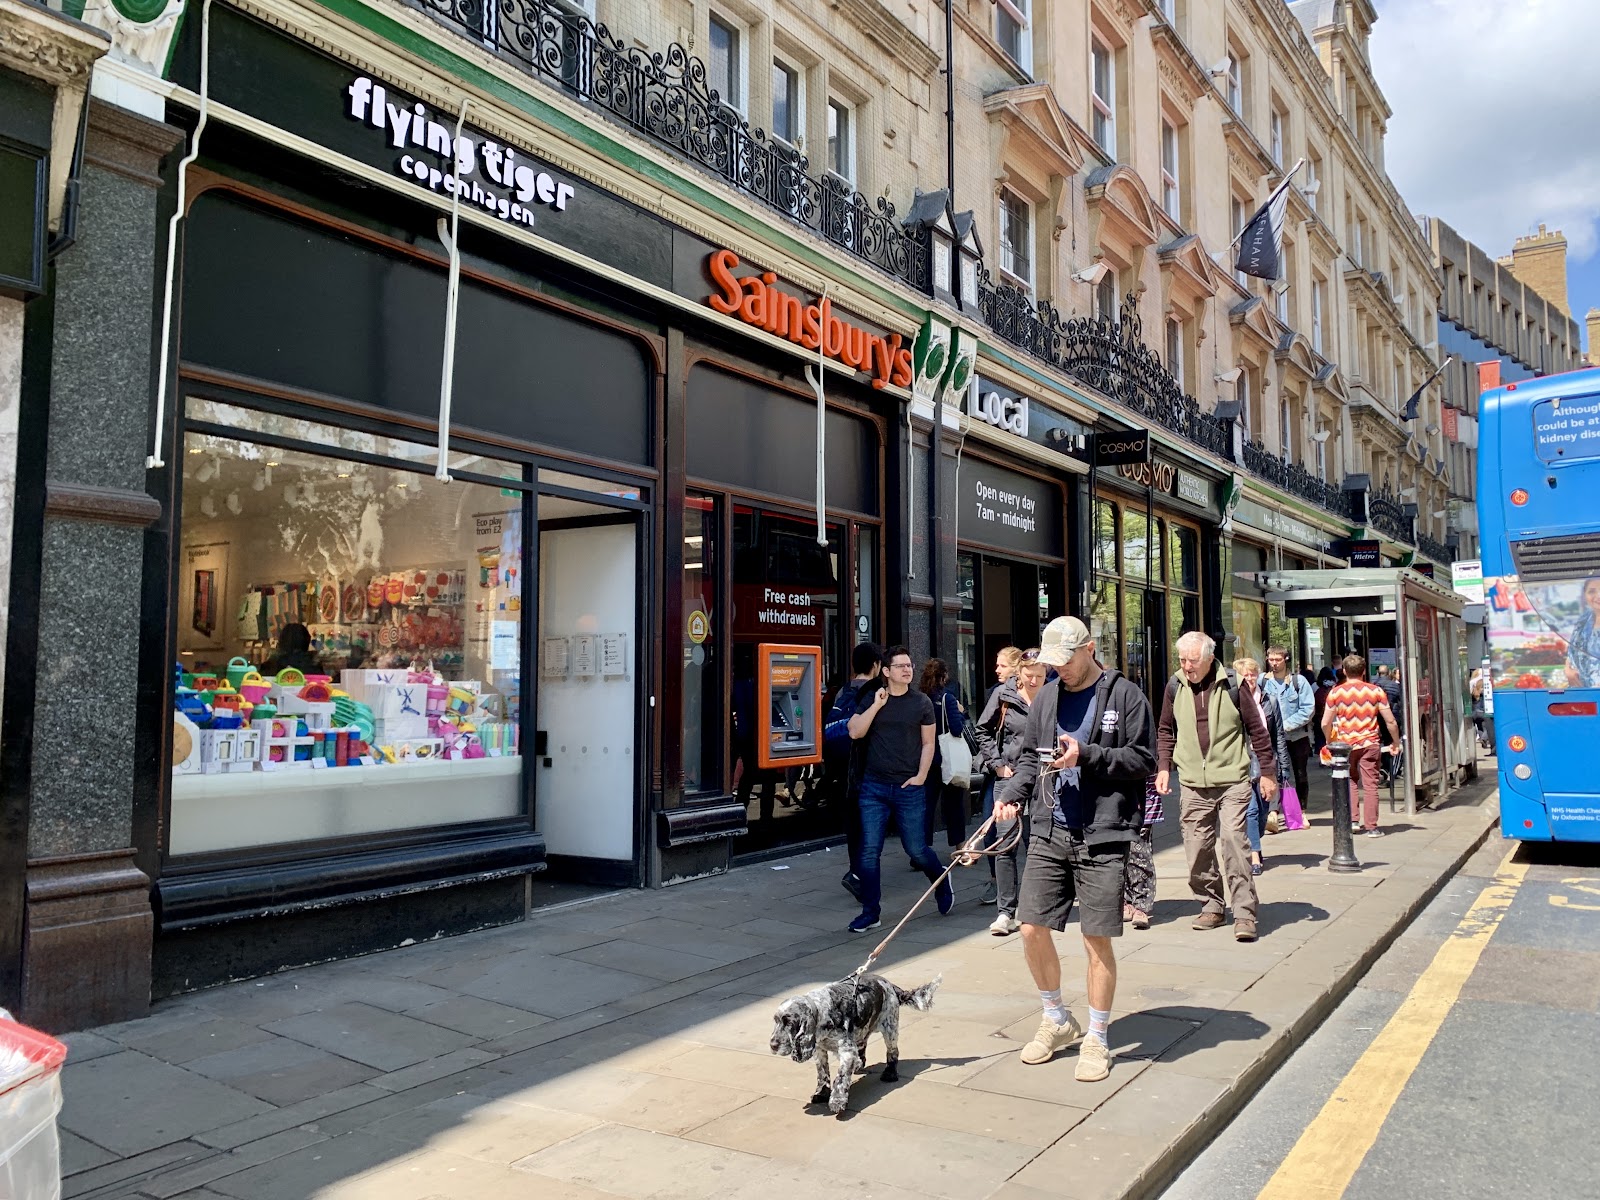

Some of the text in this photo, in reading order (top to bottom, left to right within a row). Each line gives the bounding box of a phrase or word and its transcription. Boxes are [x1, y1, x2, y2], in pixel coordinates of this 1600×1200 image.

[349, 77, 574, 211] flying tiger
[400, 154, 534, 226] copenhagen
[709, 250, 912, 390] Sainsbury's
[970, 374, 1028, 437] Local
[1552, 403, 1600, 417] Althoug
[1537, 416, 1600, 431] could be at
[1100, 440, 1144, 454] COSMO
[1540, 433, 1577, 444] kidney
[976, 480, 1036, 514] Open every day
[476, 519, 488, 527] Eco
[976, 502, 995, 521] 7am
[1002, 510, 1035, 533] midnight
[476, 527, 492, 535] from
[764, 588, 811, 606] Free cash
[758, 608, 816, 626] withdrawals
